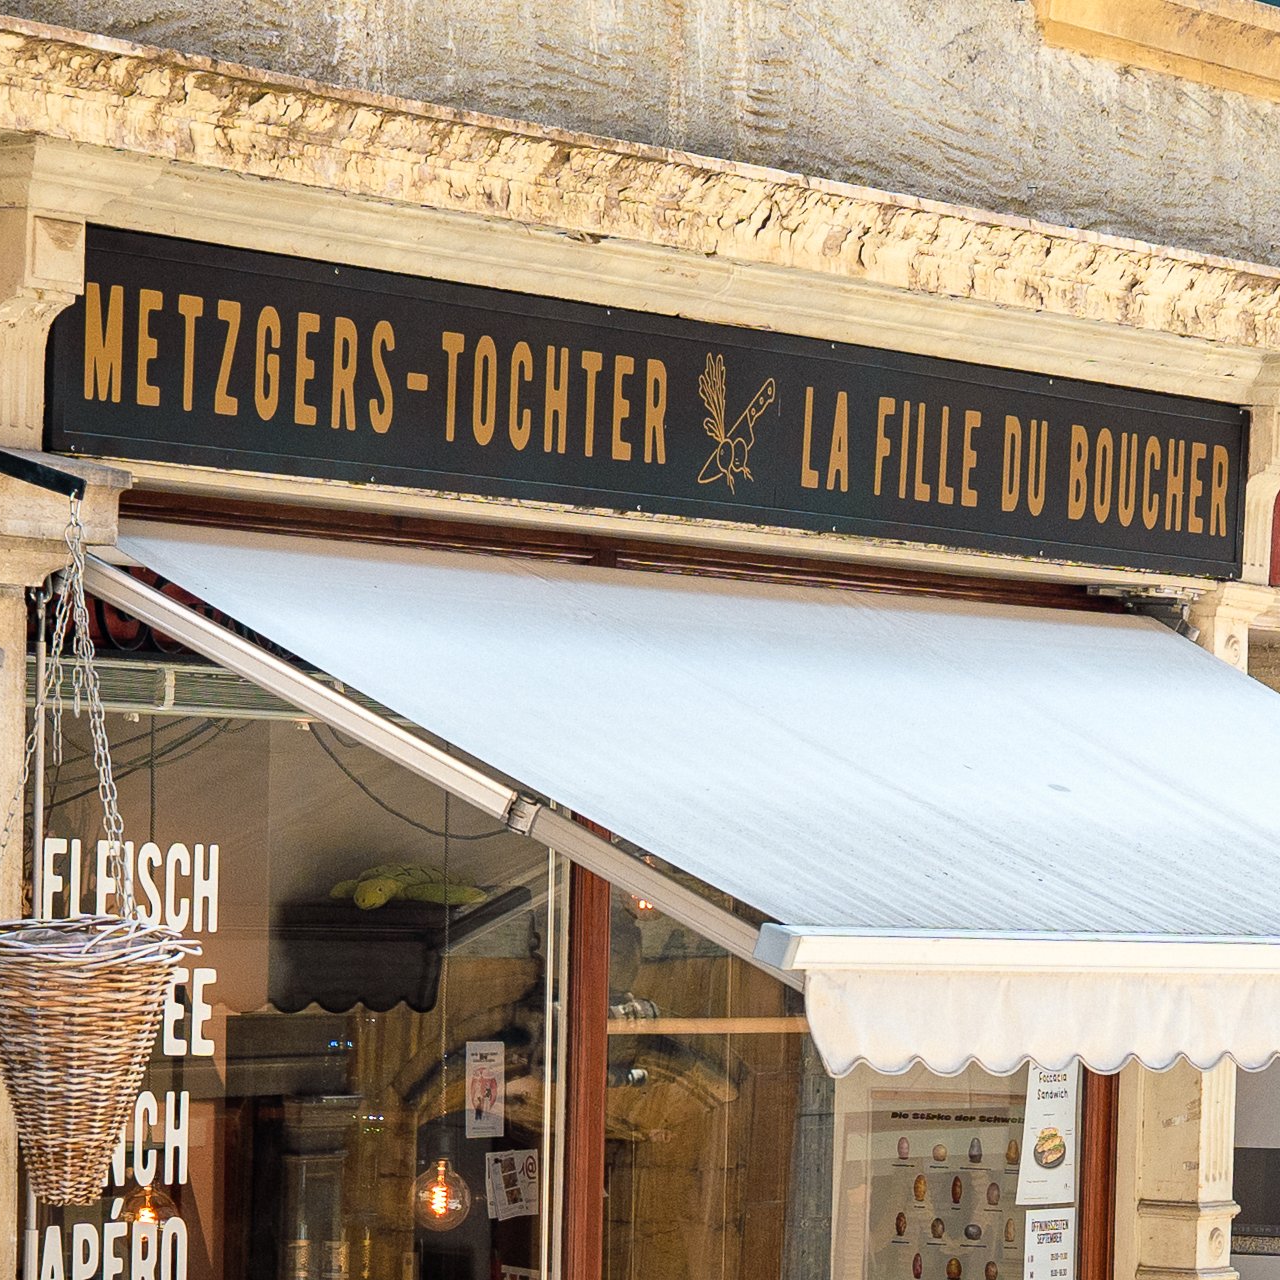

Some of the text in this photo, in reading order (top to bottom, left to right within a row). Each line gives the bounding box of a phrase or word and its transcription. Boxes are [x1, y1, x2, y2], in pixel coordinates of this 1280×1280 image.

[84, 281, 668, 465] METZGERS-TOCHTER
[800, 386, 1229, 537] LA FILLE DU BOUCHER
[43, 838, 219, 933] FLEISCH
